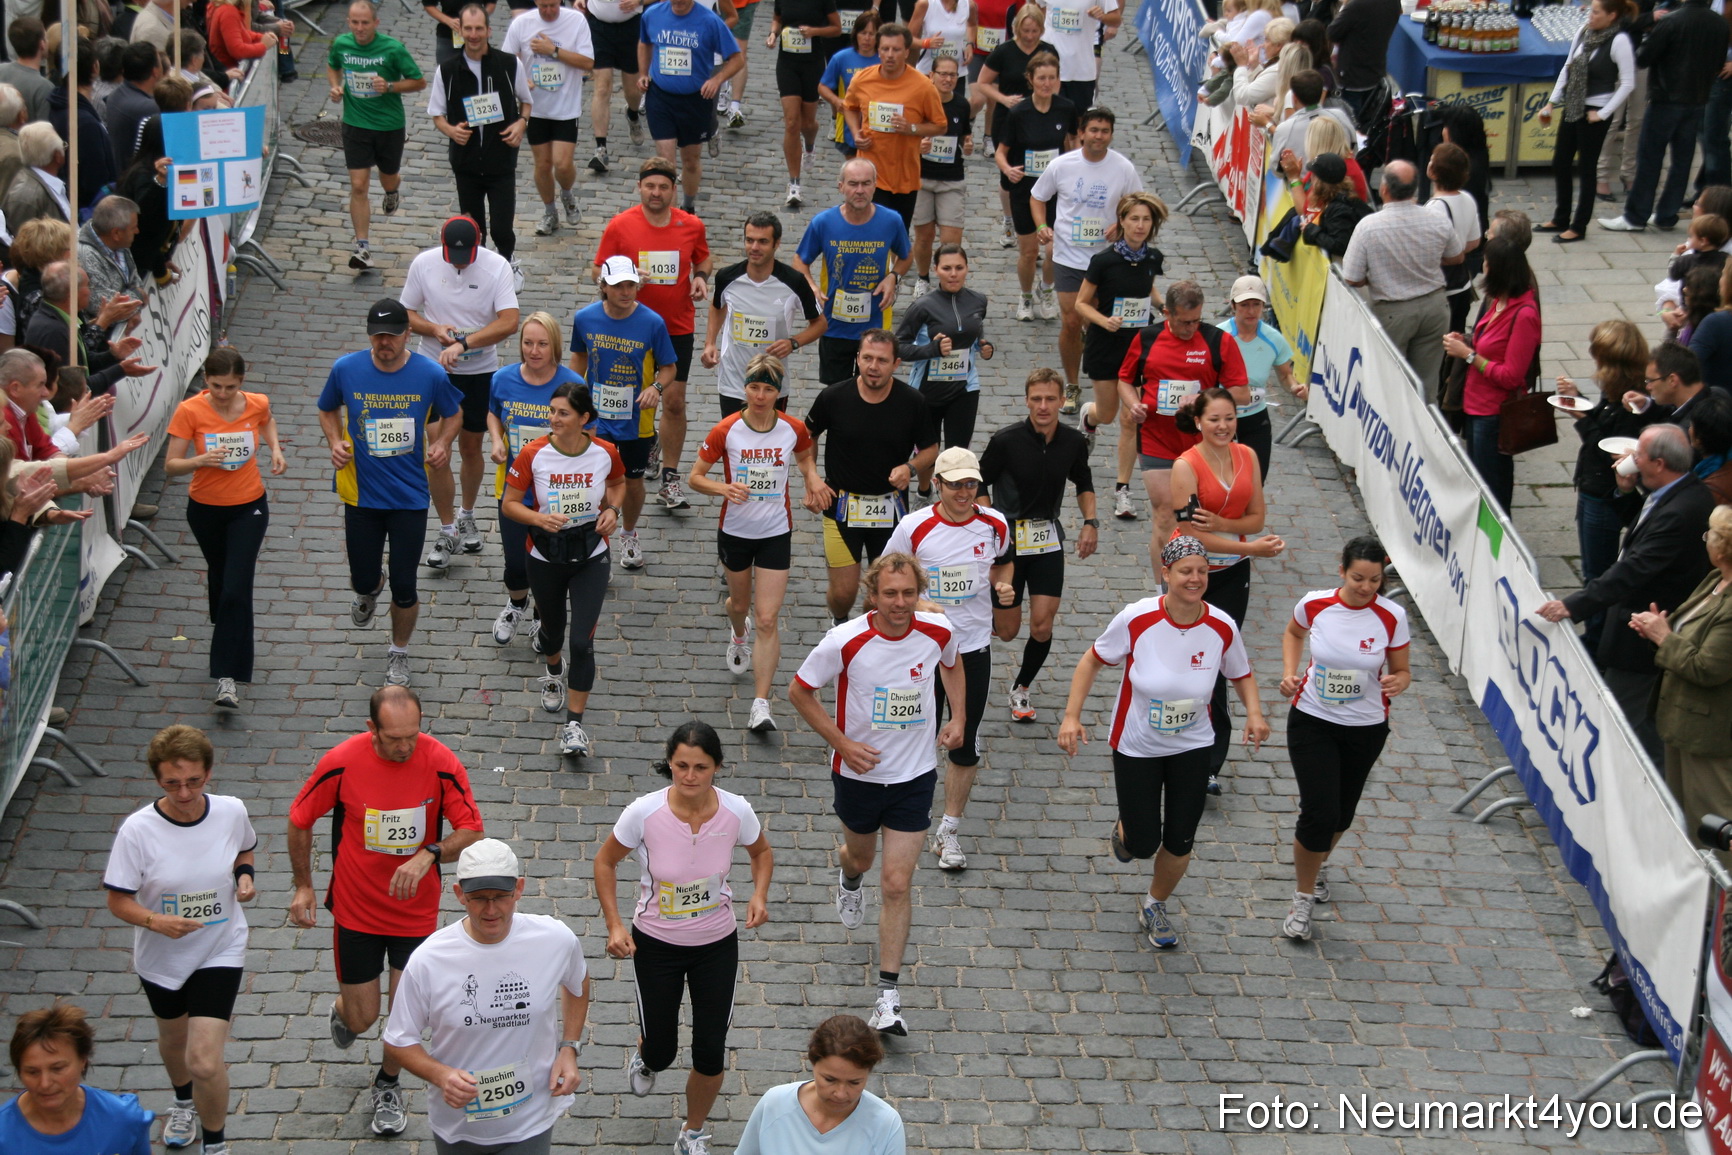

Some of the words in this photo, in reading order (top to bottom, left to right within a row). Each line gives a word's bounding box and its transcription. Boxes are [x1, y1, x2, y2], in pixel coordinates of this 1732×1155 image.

[1061, 18, 1080, 26] 3611
[791, 37, 807, 45] 223
[986, 37, 1000, 45] 784
[343, 53, 385, 69] Sinupret
[667, 58, 689, 67] 2124
[542, 74, 562, 82] 2241
[476, 104, 498, 115] 3236
[932, 145, 953, 154] 3148
[1082, 228, 1104, 236] 3821
[650, 264, 677, 274] 1038
[846, 304, 865, 314] 961
[1123, 308, 1147, 318] 2517
[744, 317, 766, 327] Werner
[748, 328, 769, 339] 729
[595, 333, 645, 349] NEUMARKTER
[593, 340, 634, 354] STADTLAUF
[941, 360, 965, 371] 3464
[602, 387, 619, 397] Dieter
[1169, 383, 1186, 391] Frank
[353, 392, 364, 400] 10.
[365, 393, 421, 402] NEUMARKTER
[363, 401, 411, 409] STADTLAUF
[512, 401, 551, 413] NEUMARK
[602, 397, 628, 409] 2968
[509, 408, 550, 420] STADTLAU
[379, 422, 394, 430] Jack
[219, 436, 245, 444] Michaela
[380, 432, 410, 443] 2685
[741, 448, 783, 464] MERZ
[750, 469, 769, 479] Margit
[550, 473, 594, 488] MERZ
[750, 480, 777, 490] 2821
[561, 492, 580, 501] Astrid
[563, 501, 592, 515] 2882
[865, 505, 887, 516] 244
[1033, 529, 1050, 543] 267
[941, 570, 961, 578] Maxim
[943, 579, 973, 592] 3207
[1328, 672, 1352, 681] Andrea
[1328, 683, 1361, 694] 3208
[1494, 575, 1600, 807] BOCK
[890, 691, 922, 702] Christoph
[890, 703, 922, 717] 3204
[1165, 704, 1176, 712] Ina
[1165, 711, 1197, 725] 3197
[381, 813, 401, 823] Fritz
[387, 826, 417, 841] 233
[676, 884, 700, 894] Nicole
[180, 891, 218, 903] Christine
[681, 890, 711, 906] 234
[182, 902, 222, 919] 2266
[494, 991, 531, 1002] 21.09.2008
[480, 1012, 531, 1025] Neumarkter
[492, 1018, 531, 1029] Stadtlauf
[479, 1070, 516, 1086] Joachim
[482, 1080, 526, 1103] 2509
